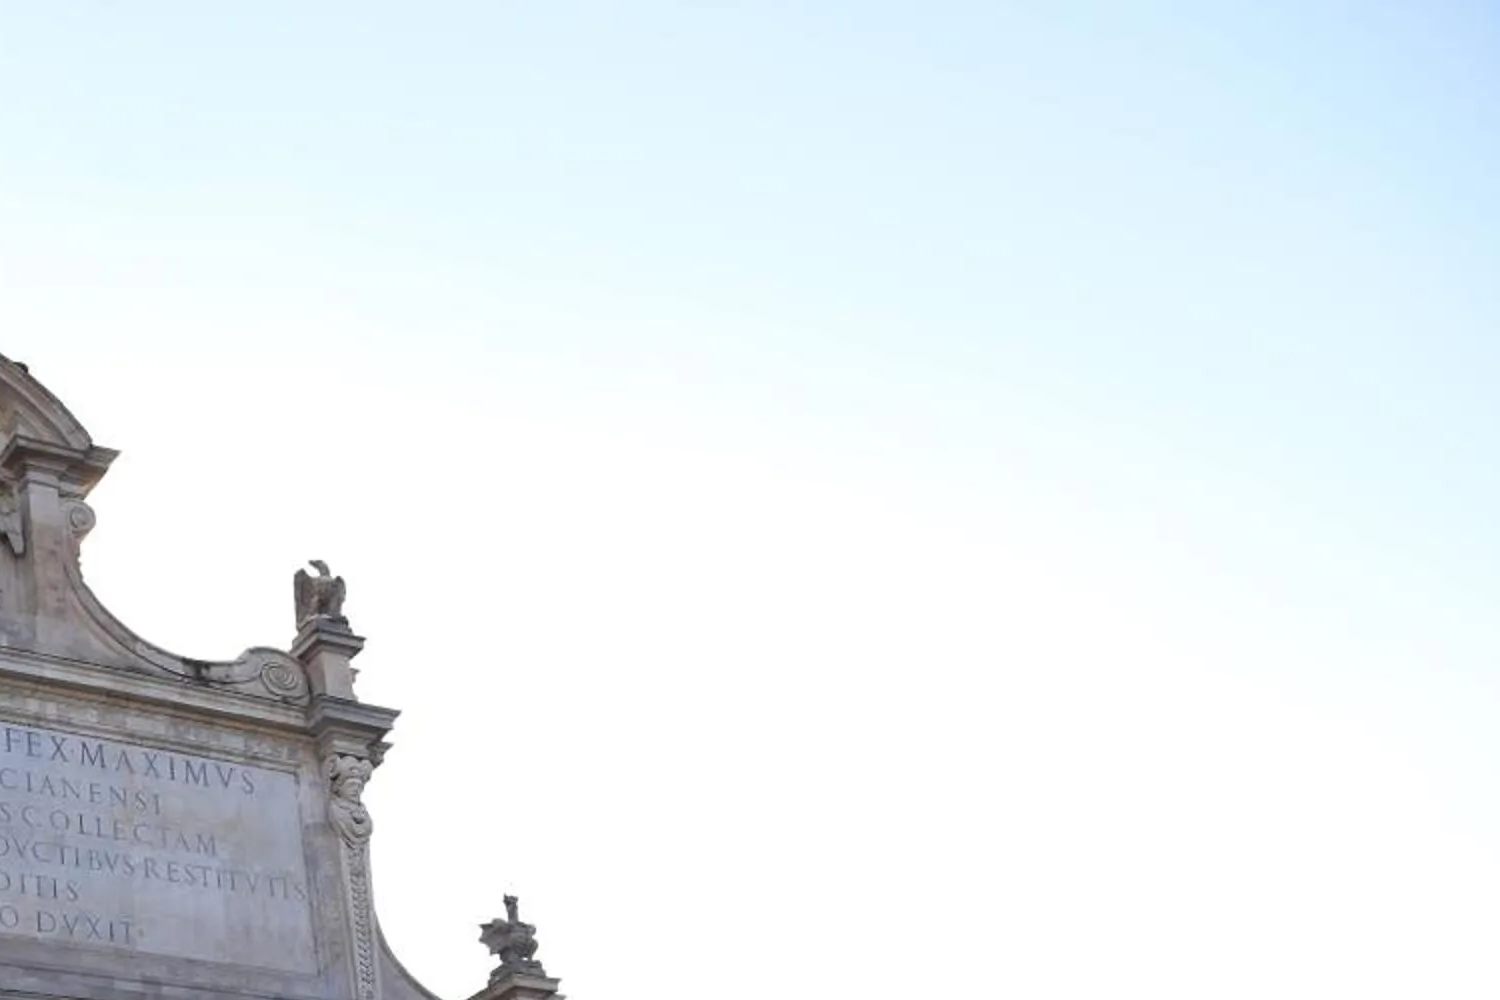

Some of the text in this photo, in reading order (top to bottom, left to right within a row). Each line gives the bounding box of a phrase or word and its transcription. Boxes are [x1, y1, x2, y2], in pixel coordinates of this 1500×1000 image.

[80, 741, 255, 795] MAXIMVS
[21, 806, 218, 857] COLLECTAM
[37, 910, 133, 945] DVXIT
